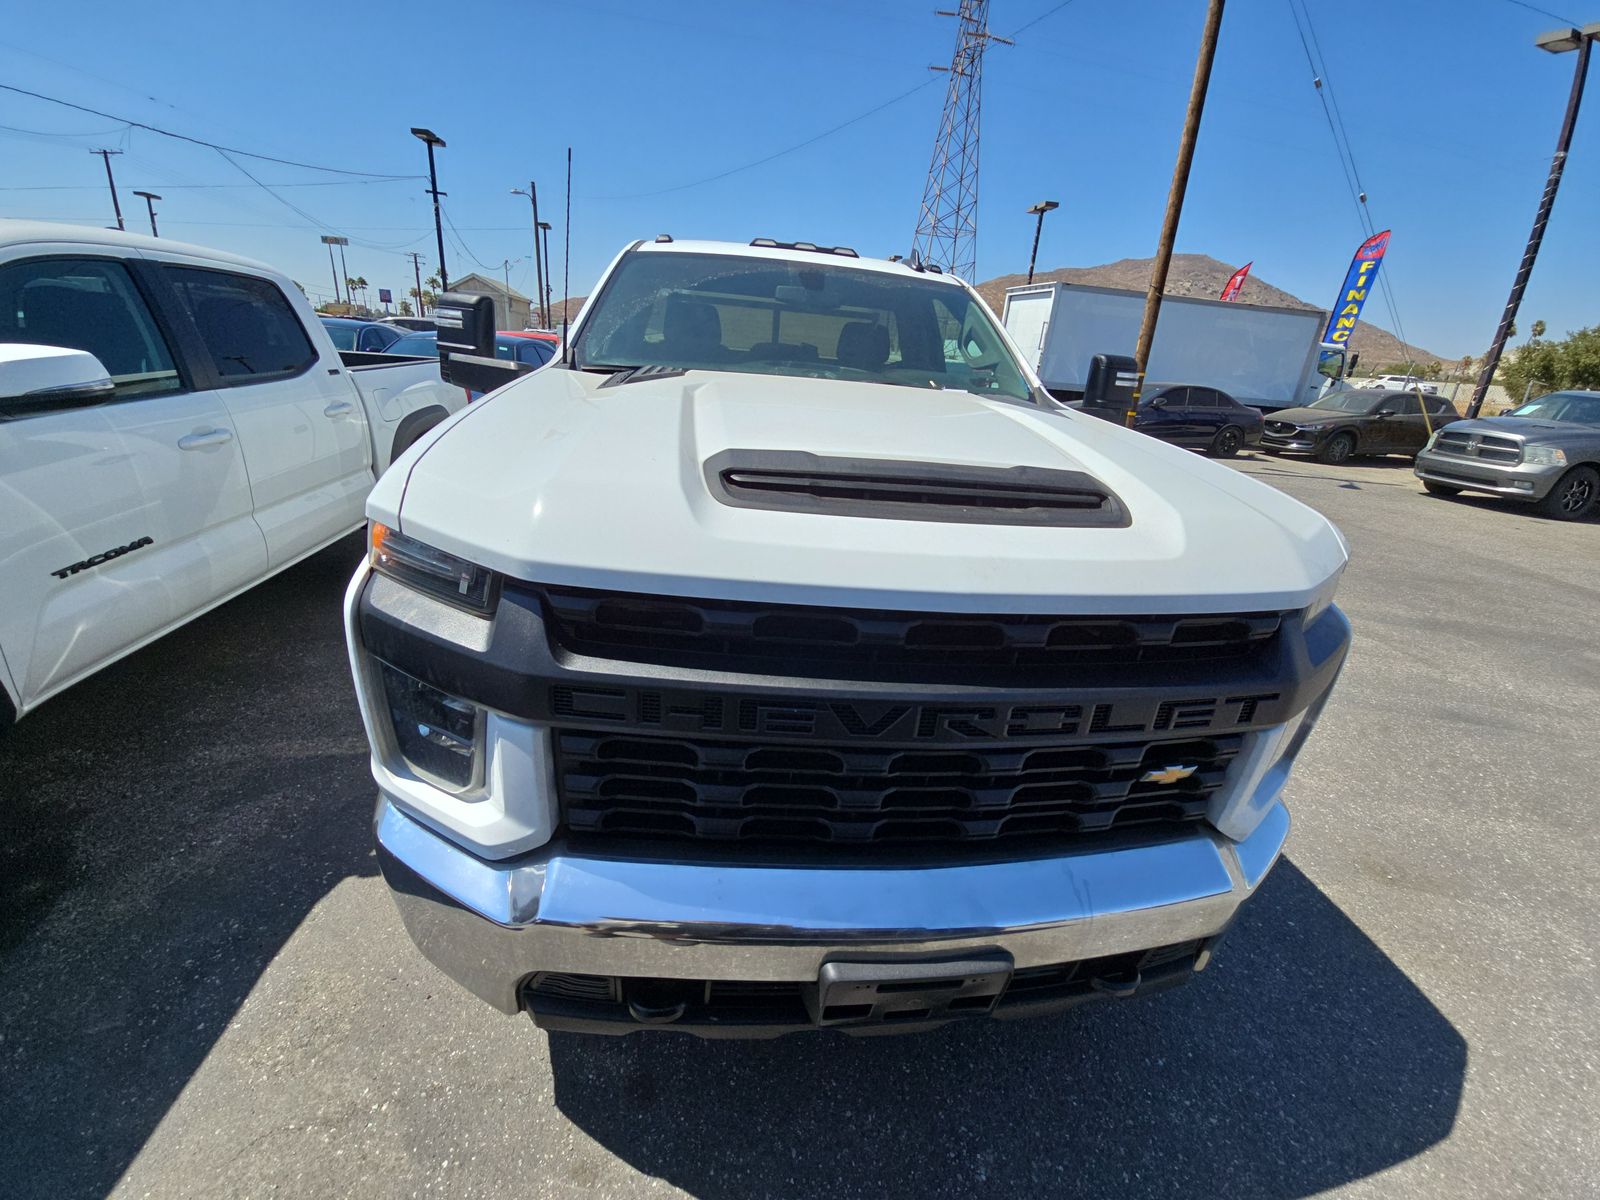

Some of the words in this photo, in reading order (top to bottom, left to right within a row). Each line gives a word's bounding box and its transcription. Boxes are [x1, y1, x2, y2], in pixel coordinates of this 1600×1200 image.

[1331, 260, 1376, 347] FINANC
[50, 536, 154, 579] TACOMA
[552, 683, 1281, 738] CHEVROLET
